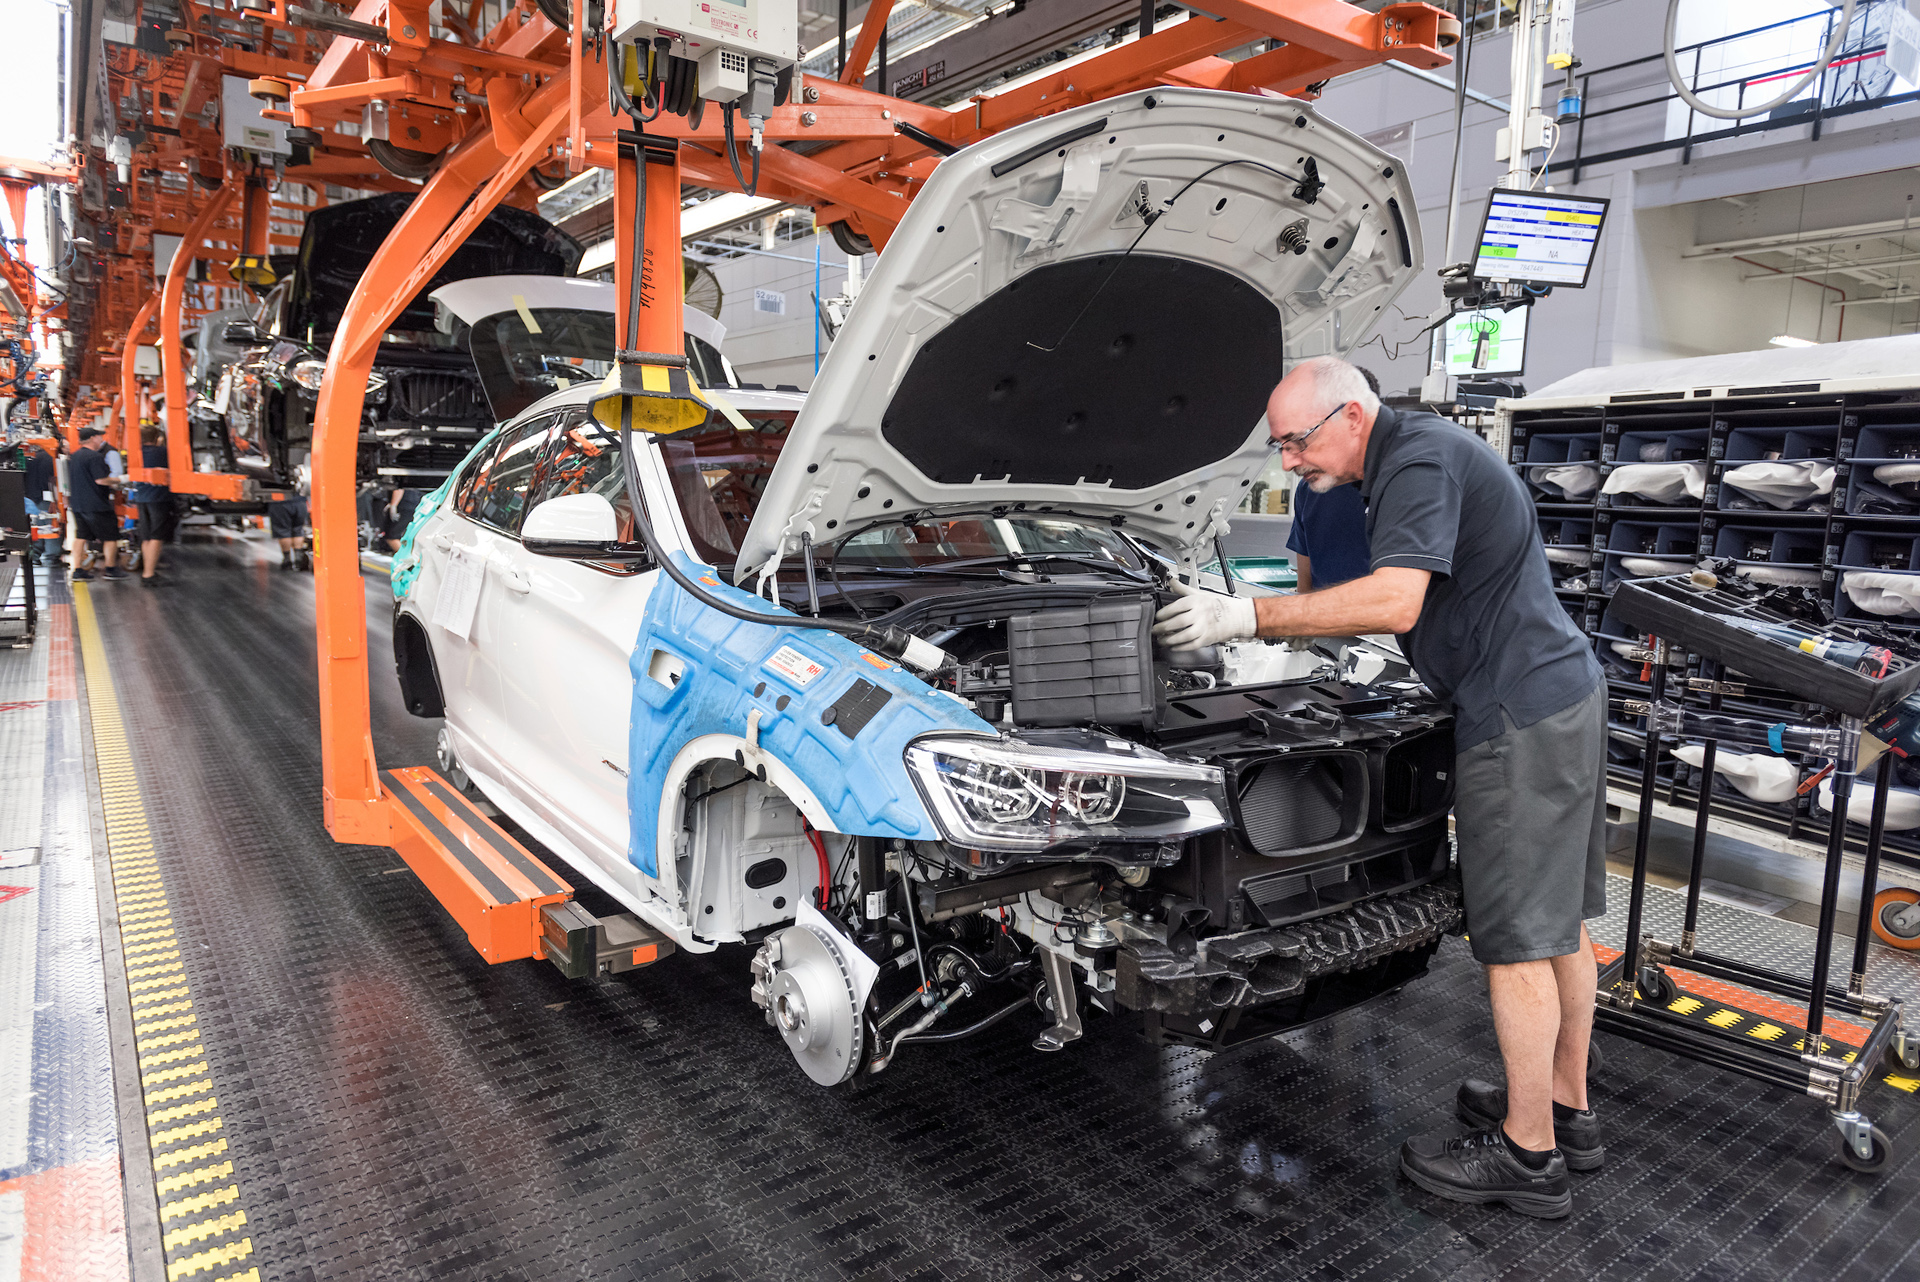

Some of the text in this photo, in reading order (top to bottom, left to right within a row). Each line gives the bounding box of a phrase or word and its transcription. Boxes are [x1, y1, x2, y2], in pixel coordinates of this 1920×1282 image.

[896, 70, 923, 87] KNIGHT
[1548, 250, 1559, 258] NA
[755, 291, 765, 299] 52
[806, 664, 821, 676] RH
[1882, 717, 1898, 728] BOSCH
